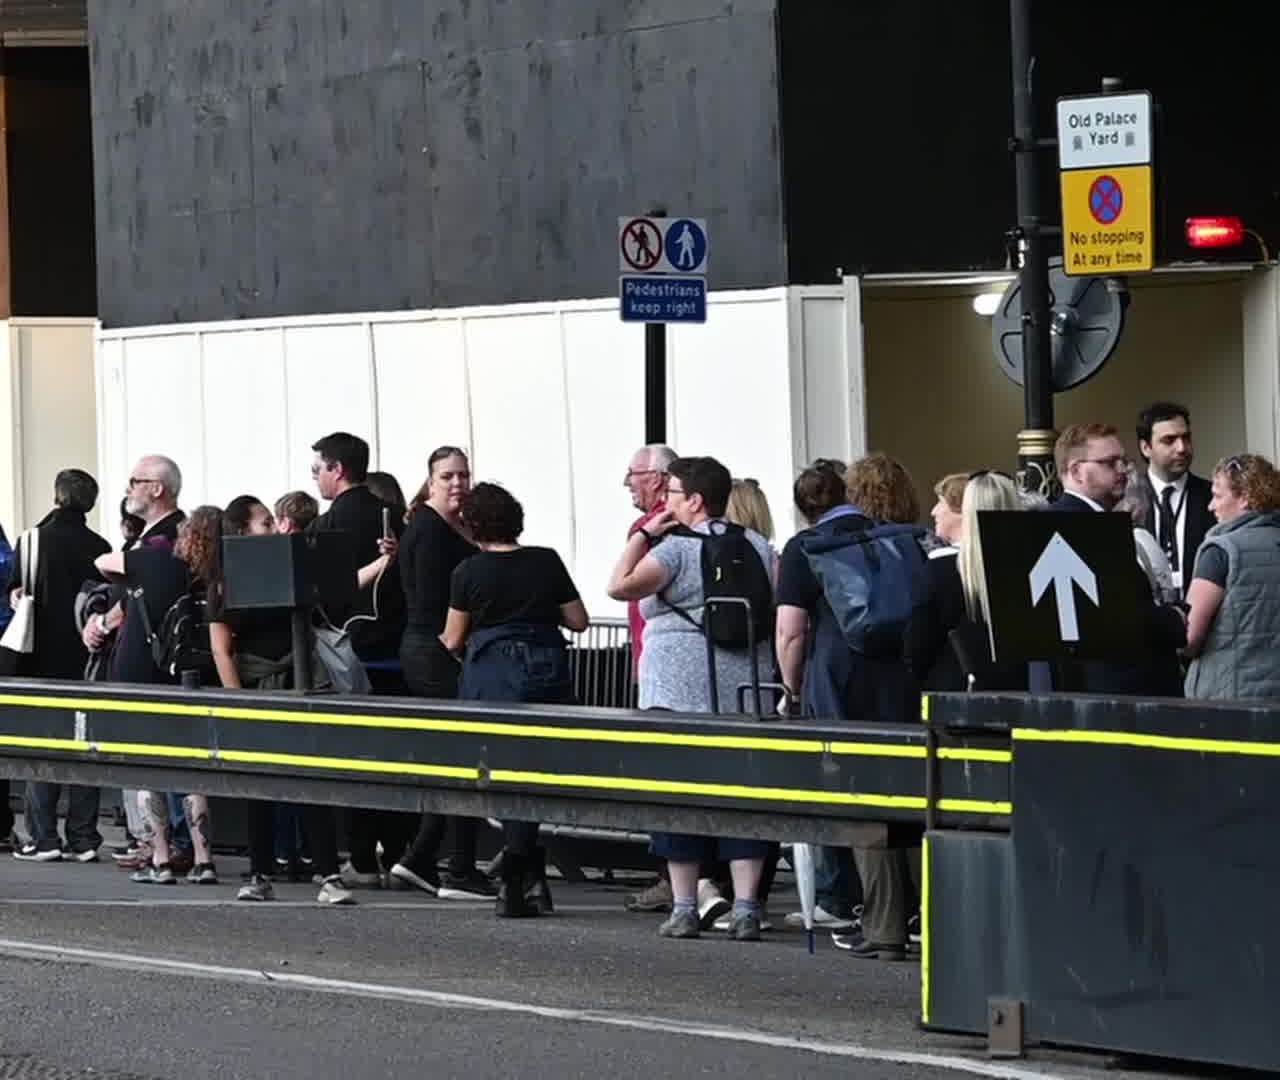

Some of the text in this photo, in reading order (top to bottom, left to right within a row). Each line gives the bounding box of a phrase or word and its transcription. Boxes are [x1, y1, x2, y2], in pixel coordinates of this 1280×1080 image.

[1068, 111, 1137, 129] Old Palace
[1089, 131, 1119, 145] Yard
[1070, 229, 1144, 246] No stopping
[1073, 250, 1143, 267] At any time
[625, 281, 700, 297] Pedestrians
[631, 300, 696, 317] keep right
